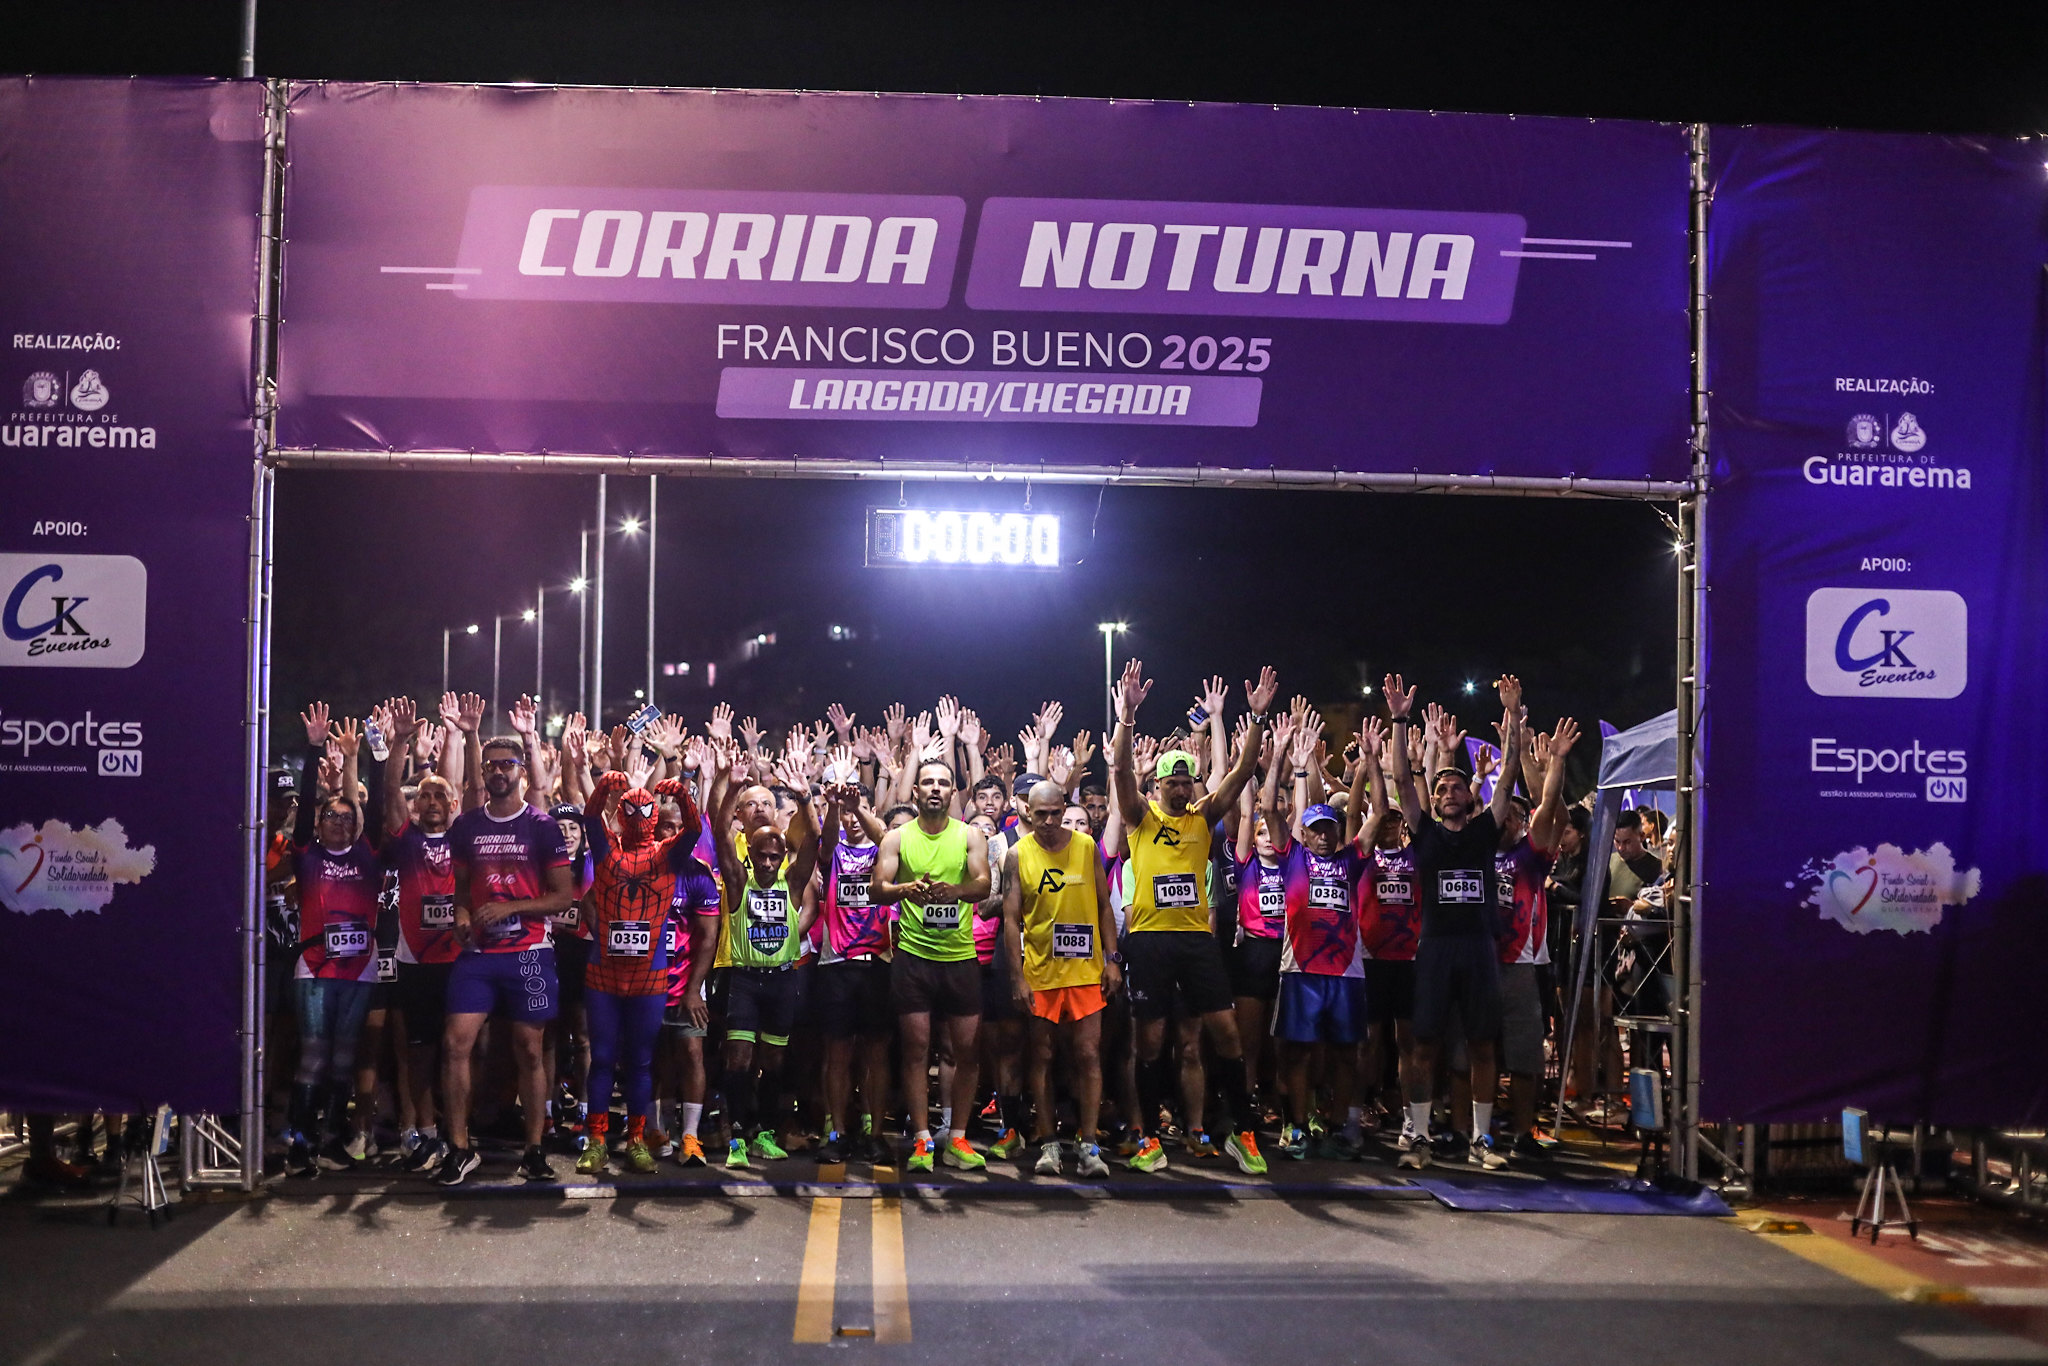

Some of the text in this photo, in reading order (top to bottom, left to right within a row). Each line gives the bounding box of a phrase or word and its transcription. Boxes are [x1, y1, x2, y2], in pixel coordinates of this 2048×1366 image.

[518, 207, 1475, 301] CORRIDA NOTURNA
[13, 332, 121, 353] REALIZAÇÃO:
[716, 323, 1272, 373] FRANCISCO BUENO 2025
[1835, 376, 1935, 396] REALIZAÇÃO:
[788, 378, 1192, 418] LARGADA/CHEGADA
[11, 413, 118, 424] PREFEITURA DE
[0, 424, 157, 450] uararema
[1838, 453, 1936, 464] PREFEITURA DE
[1803, 456, 1971, 489] Guararema
[33, 520, 88, 537] APOIO:
[1860, 557, 1912, 572] APOIO:
[27, 637, 112, 657] Eventos
[1858, 668, 1938, 688] Eventos
[0, 710, 143, 757] sportes
[102, 752, 138, 772] ON
[1811, 737, 1968, 784] Esportes
[53, 765, 87, 773] ESPORTIVA
[1930, 779, 1964, 799] ON
[557, 804, 574, 814] NYC
[473, 834, 516, 845] CORRIDA
[479, 844, 525, 854] NOTURNA
[48, 850, 73, 864] Fundo
[75, 850, 99, 864] Social
[47, 866, 109, 882] Solidariedade
[1160, 885, 1191, 897] 1089
[1380, 883, 1408, 894] 0019
[1445, 881, 1477, 892] 0686
[1261, 894, 1284, 905] 003
[1314, 888, 1345, 901] 0384
[427, 906, 454, 918] 1036
[754, 901, 782, 911] 0331
[926, 906, 957, 918] 0610
[331, 933, 365, 946] 0568
[614, 933, 648, 945] 0350
[748, 925, 789, 940] TAKAO'S
[1056, 935, 1086, 947] 1088
[518, 949, 549, 1012] BOSS
